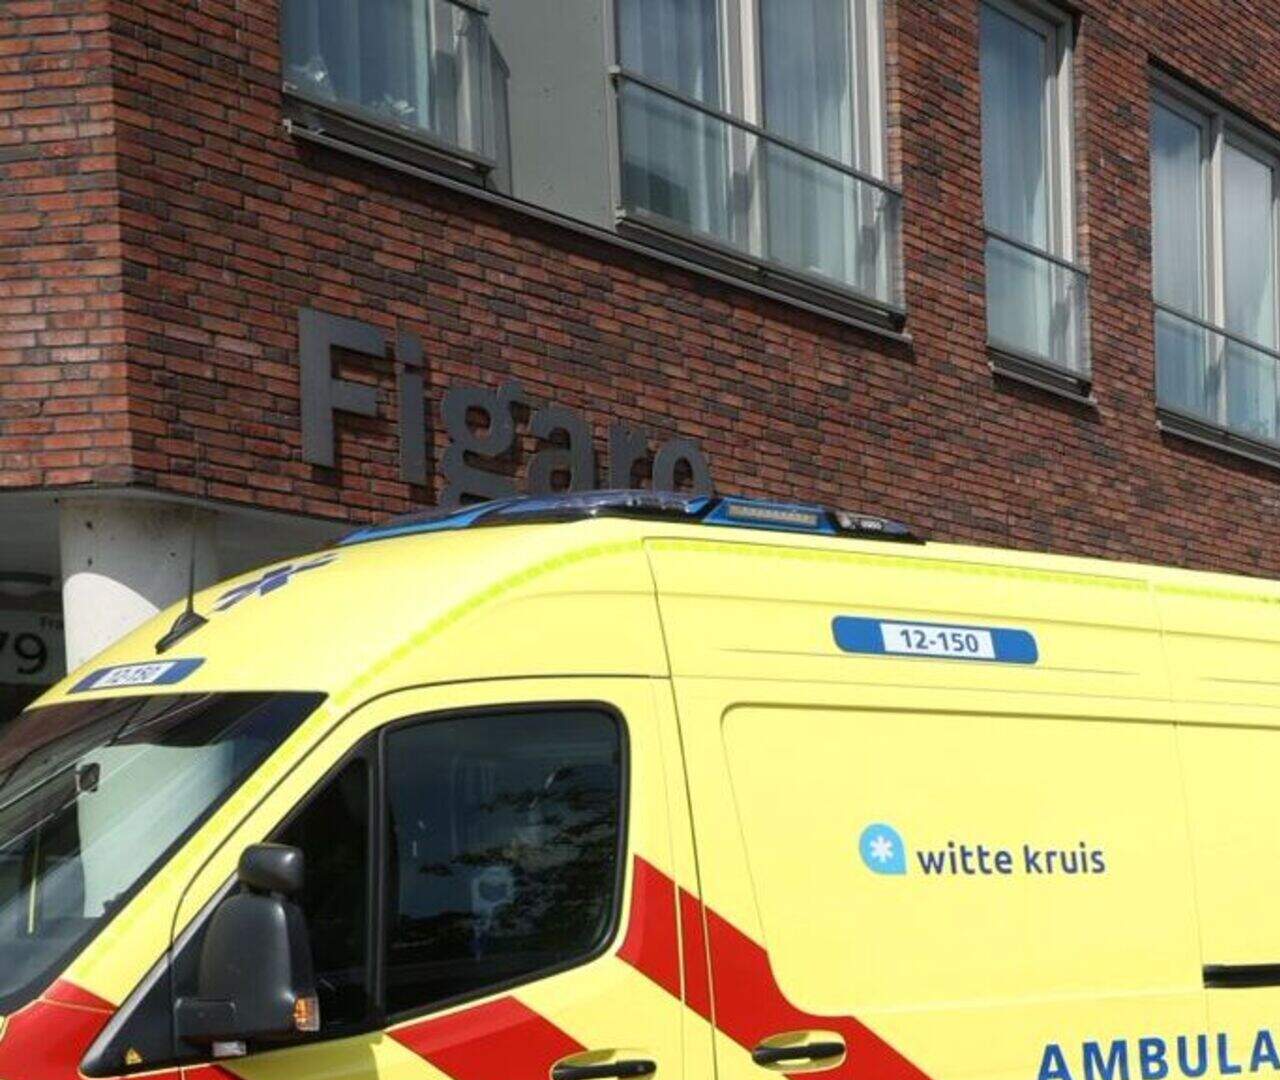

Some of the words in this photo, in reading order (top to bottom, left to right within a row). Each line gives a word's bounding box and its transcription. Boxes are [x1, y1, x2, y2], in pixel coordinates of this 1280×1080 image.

[300, 309, 717, 506] Figaro
[899, 629, 979, 653] 12-150
[917, 841, 1013, 875] witte
[1023, 841, 1106, 874] kruis
